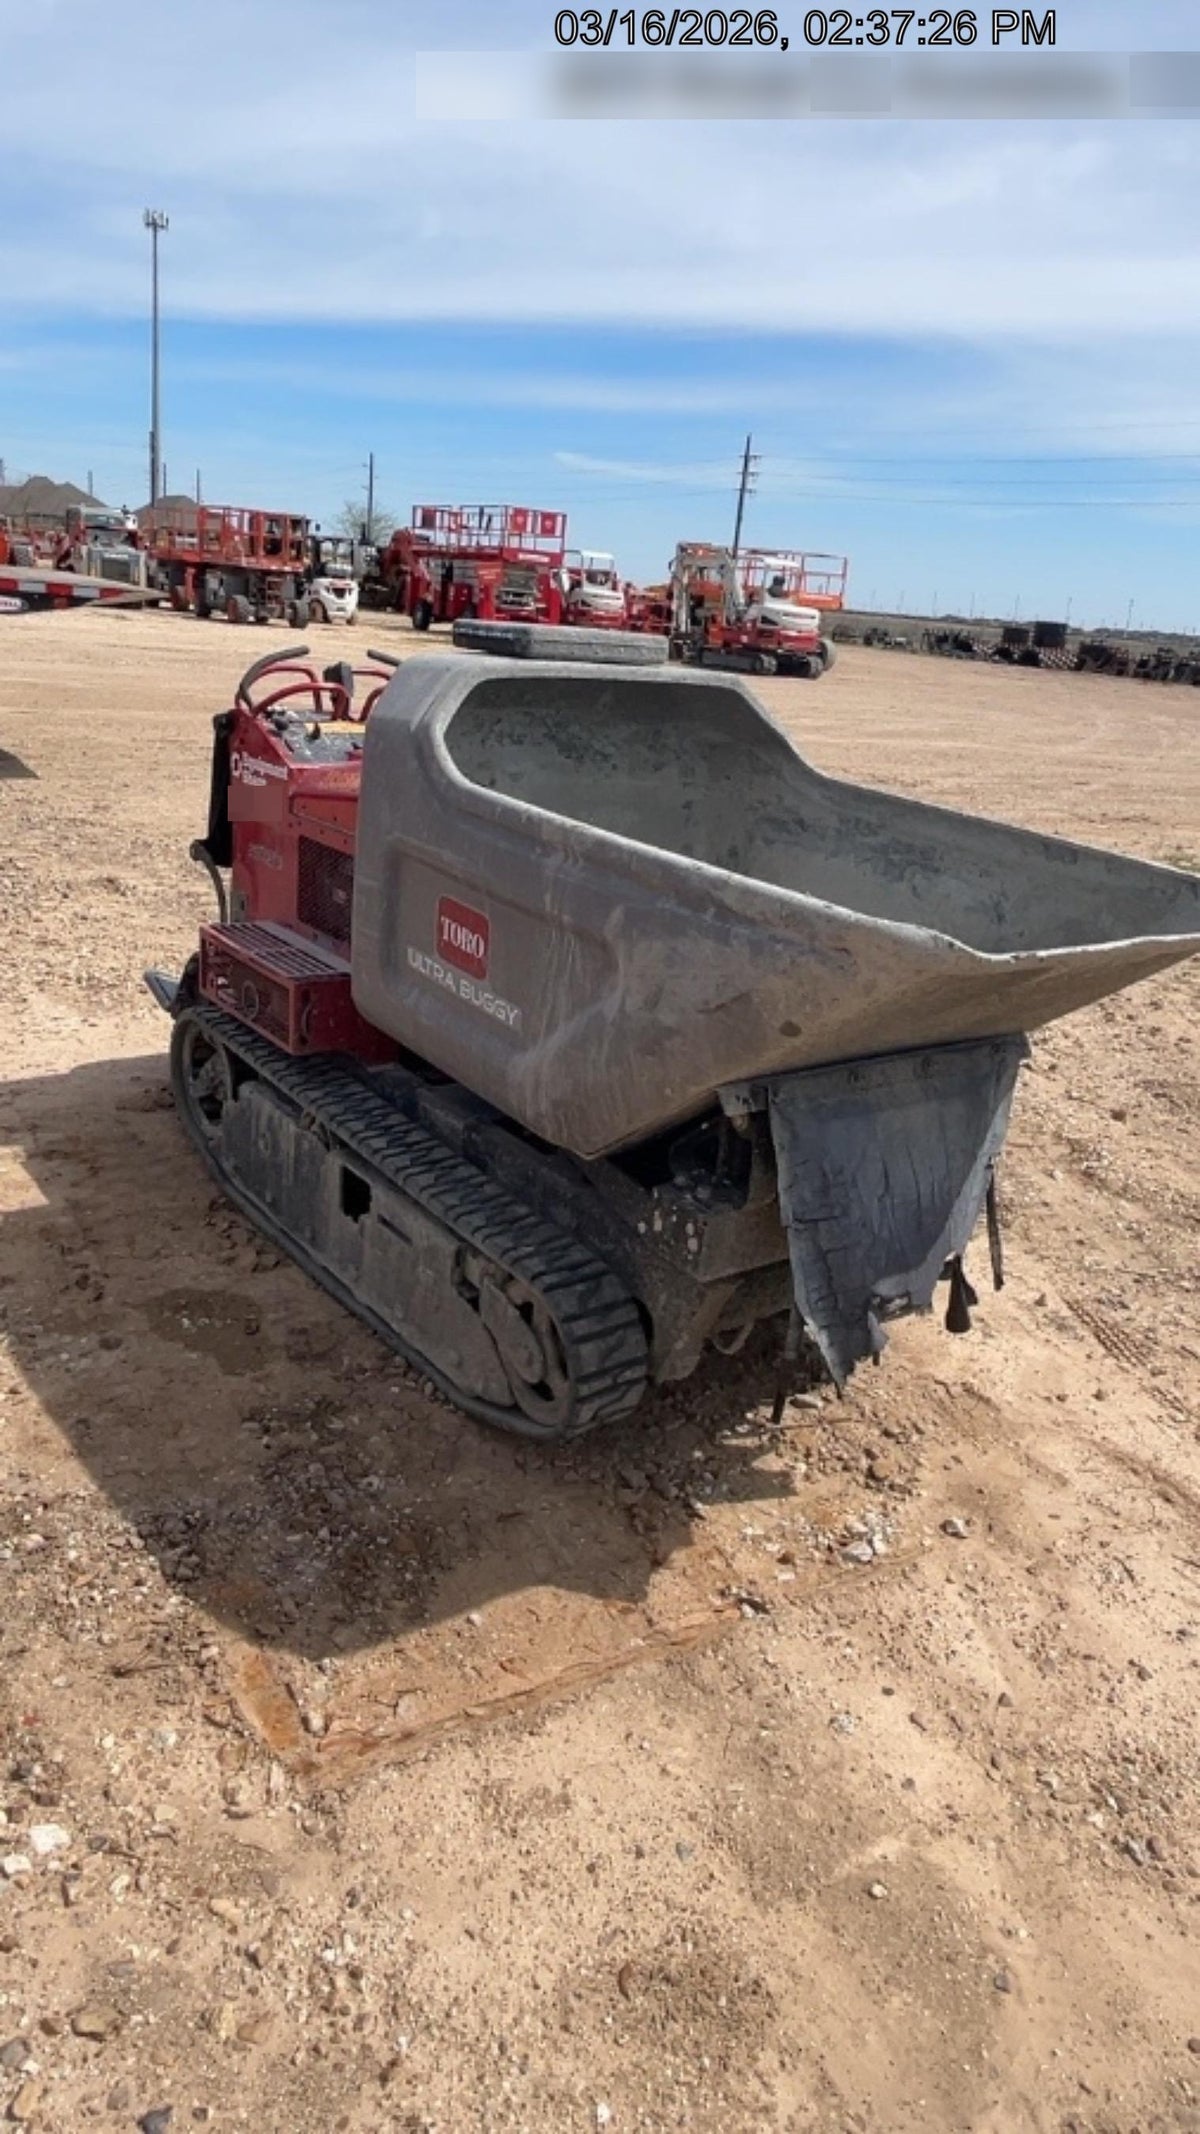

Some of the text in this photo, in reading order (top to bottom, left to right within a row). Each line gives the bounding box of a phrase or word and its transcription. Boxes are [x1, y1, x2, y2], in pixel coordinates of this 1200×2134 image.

[441, 916, 485, 959] TORO
[407, 947, 519, 1027] ULTRA BUGGY
